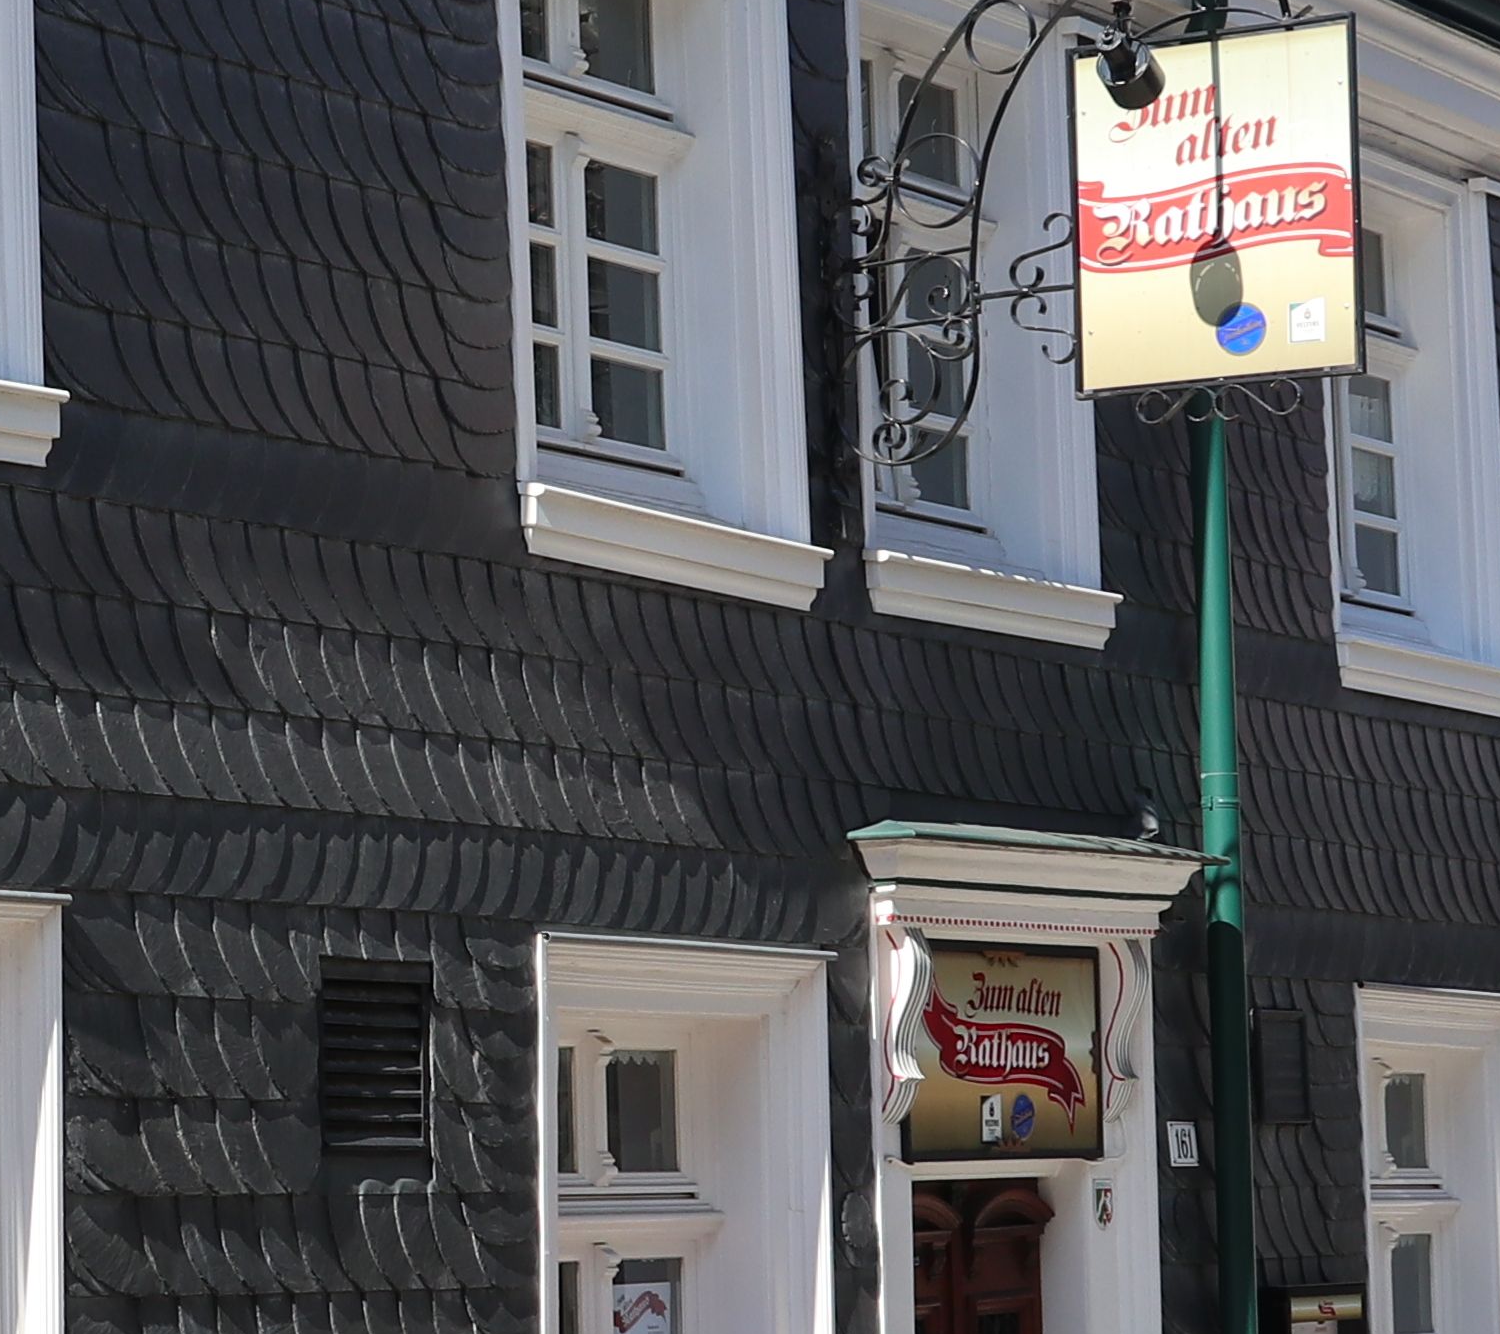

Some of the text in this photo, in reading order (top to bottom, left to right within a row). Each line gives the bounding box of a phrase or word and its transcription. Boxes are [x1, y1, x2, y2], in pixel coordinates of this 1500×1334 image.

[1175, 114, 1278, 167] alten
[1092, 179, 1328, 266] Rathaus
[964, 971, 1062, 1018] Zum alten
[952, 1024, 1050, 1079] Rathaus
[1174, 1128, 1195, 1160] 161
